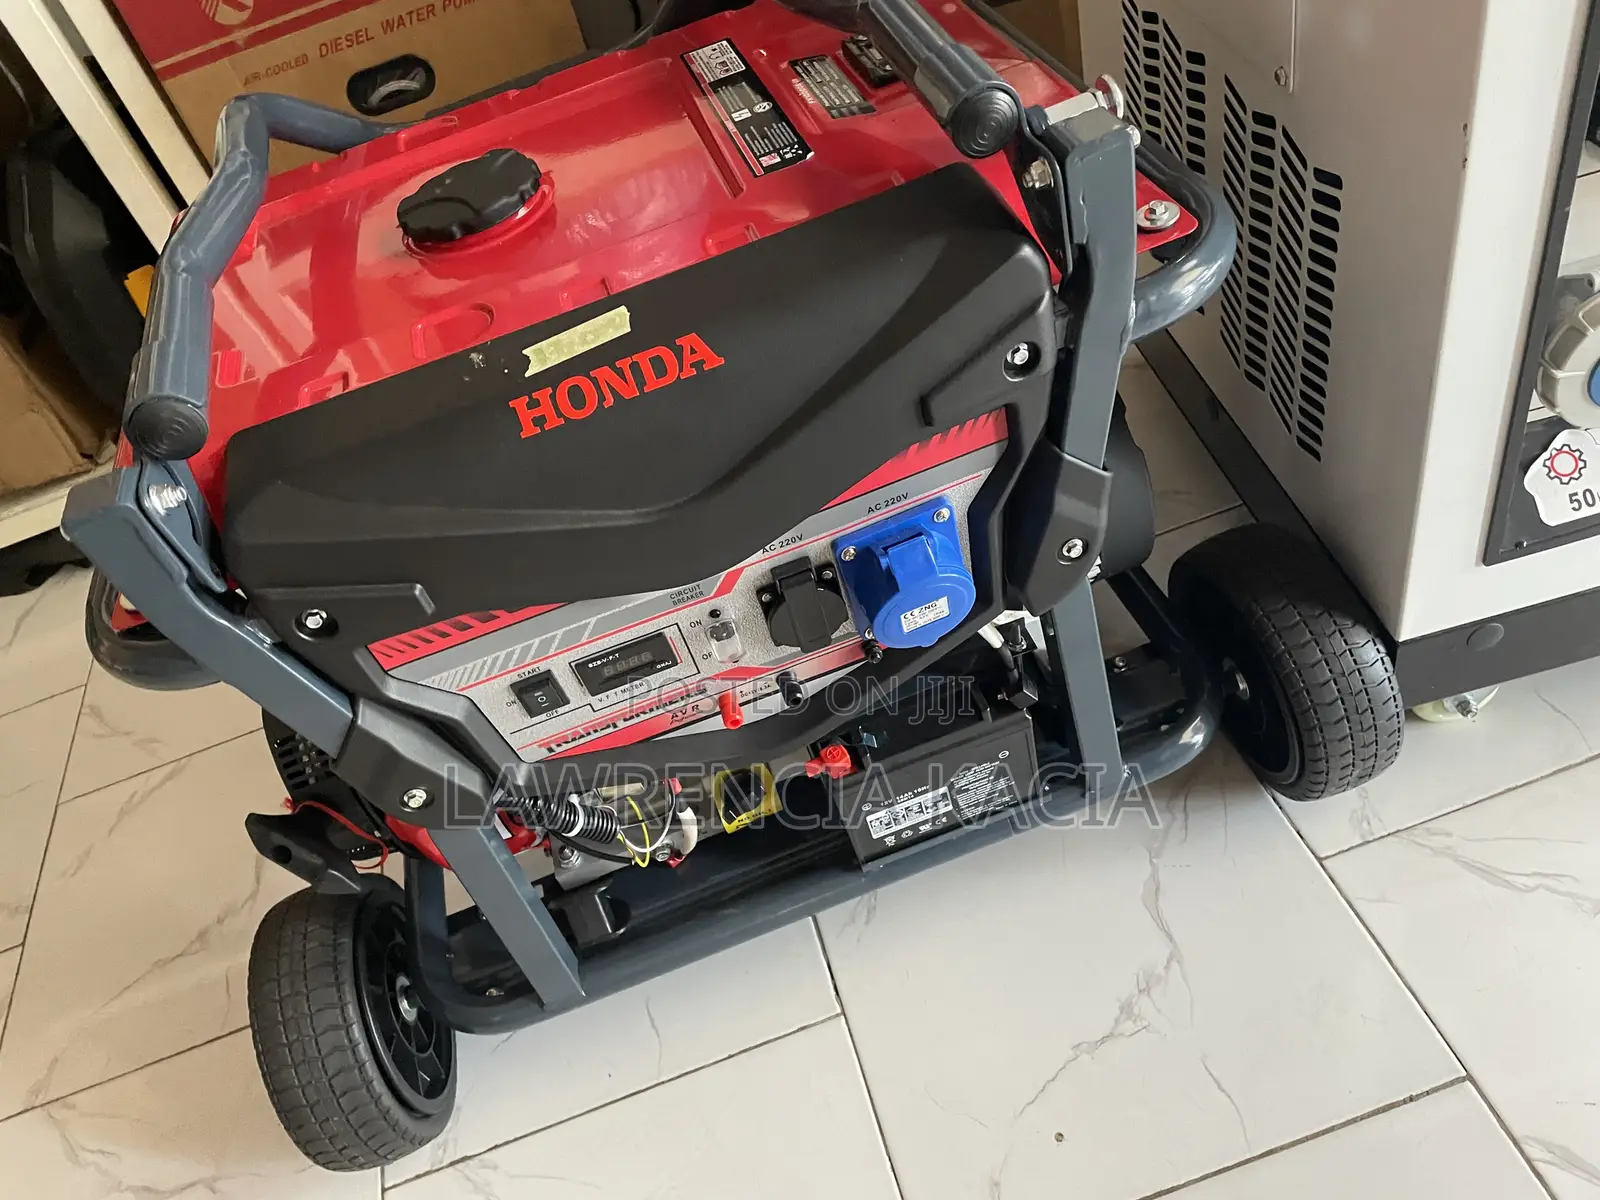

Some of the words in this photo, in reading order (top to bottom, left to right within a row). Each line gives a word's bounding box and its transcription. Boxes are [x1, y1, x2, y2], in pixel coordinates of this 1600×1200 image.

[318, 27, 375, 58] DIESEL
[380, 2, 437, 35] WATER
[508, 332, 725, 439] HONDA
[867, 503, 882, 514] AC
[884, 492, 910, 508] 220V
[761, 544, 776, 555] AC
[779, 533, 804, 549] 220V
[669, 585, 701, 600] CIRCUIT
[672, 590, 705, 606] BREAKER
[689, 619, 702, 629] ON
[517, 666, 542, 679] START
[506, 699, 517, 708] ON
[545, 709, 560, 718] OFF
